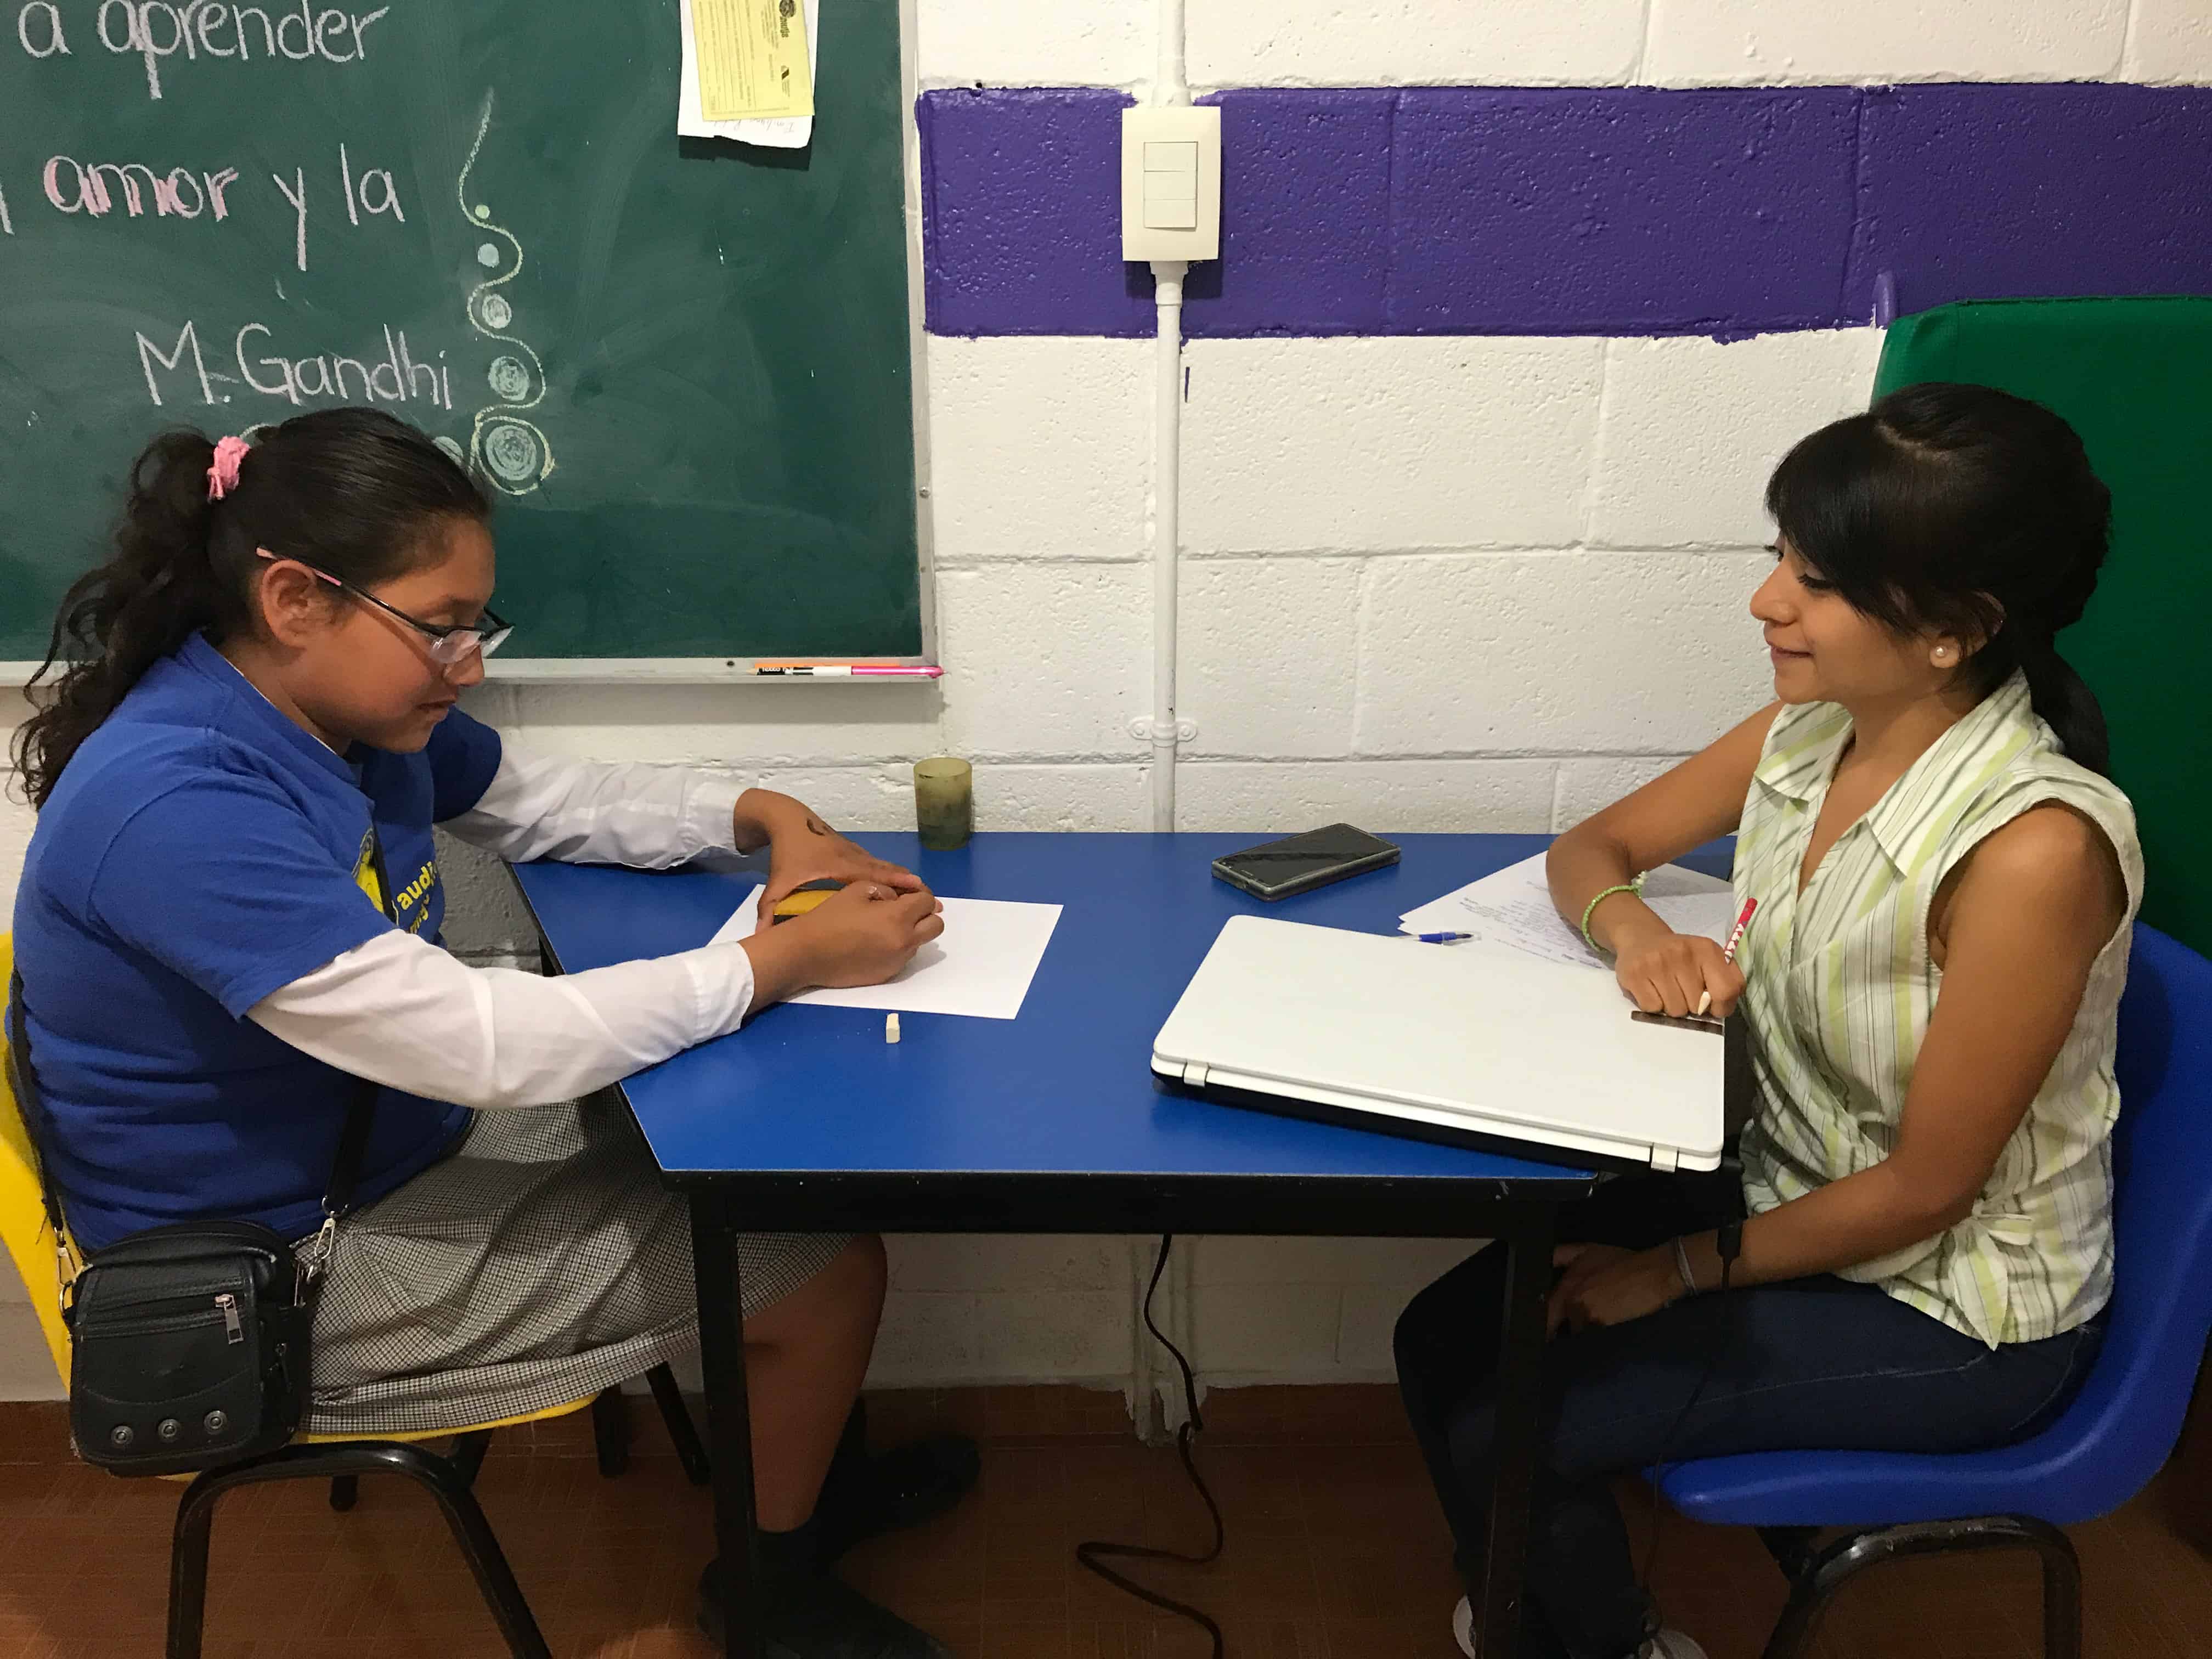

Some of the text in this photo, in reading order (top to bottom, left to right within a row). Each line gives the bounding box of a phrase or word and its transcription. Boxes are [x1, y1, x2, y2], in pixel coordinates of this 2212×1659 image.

[18, 0, 390, 100] a aprender
[43, 155, 239, 223] amor
[273, 167, 308, 272] y
[341, 143, 407, 225] la
